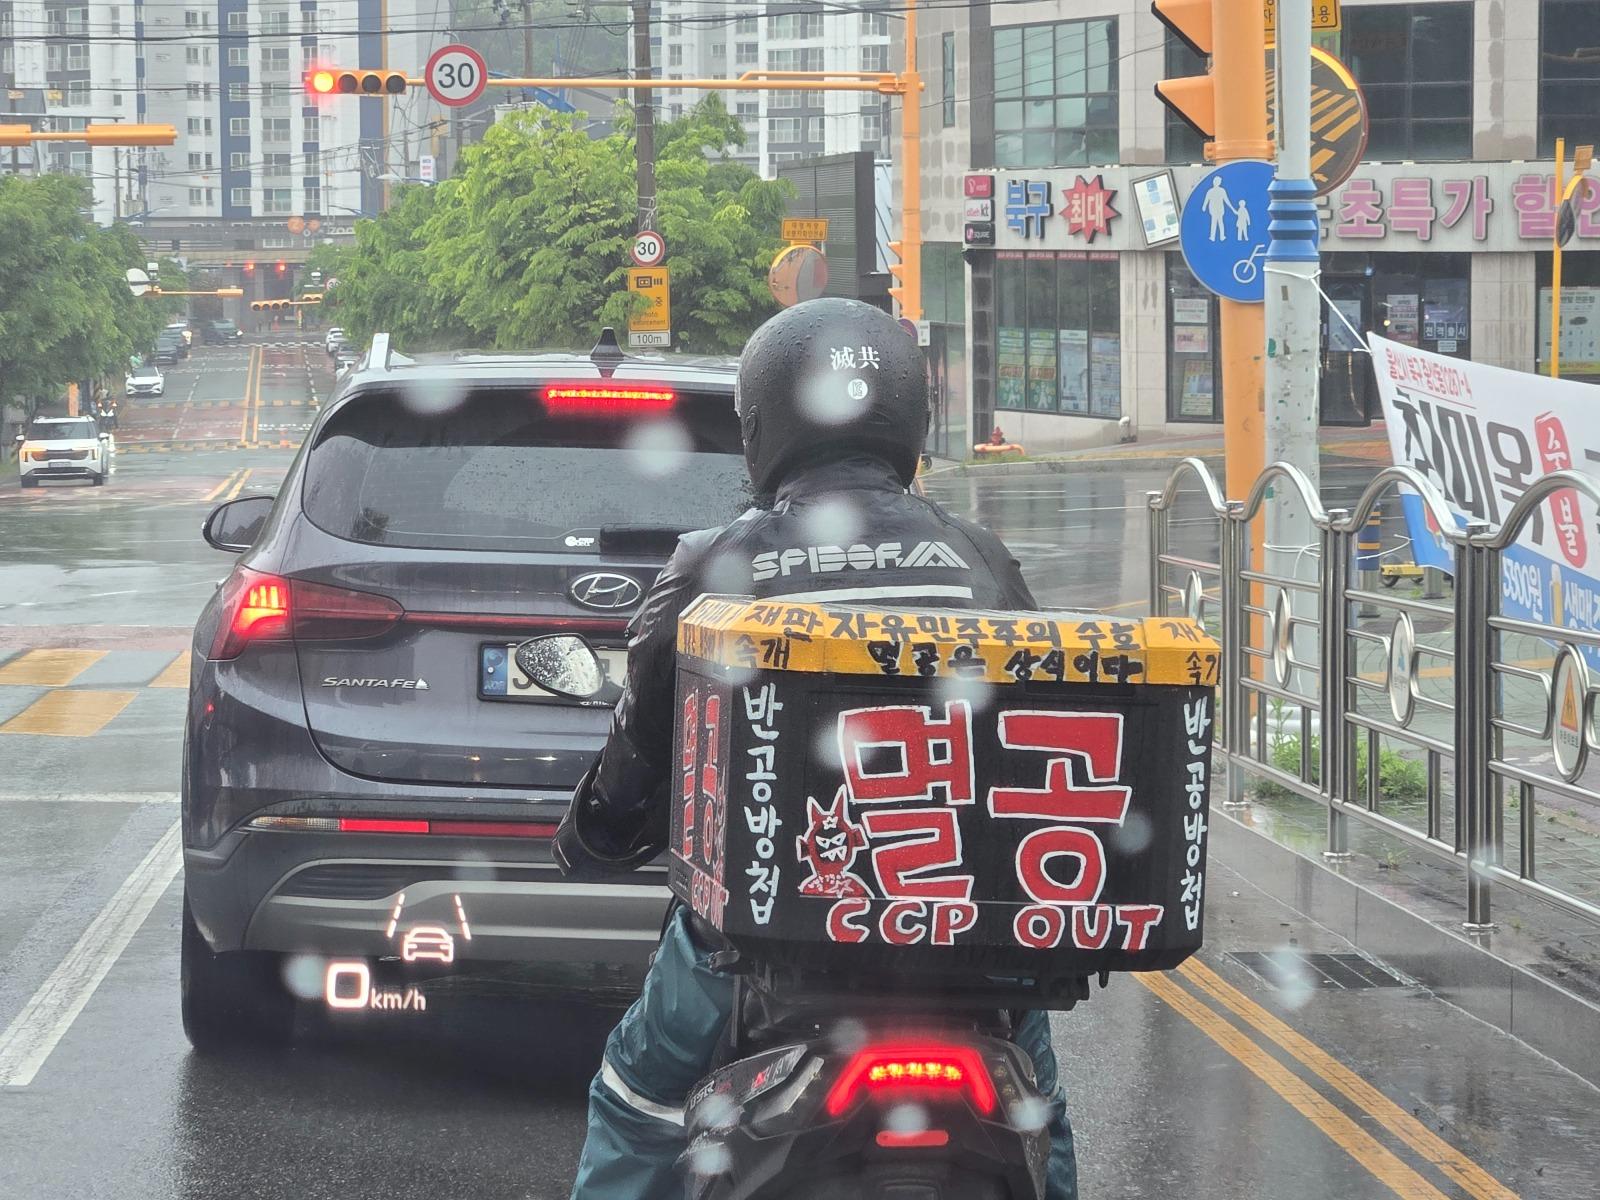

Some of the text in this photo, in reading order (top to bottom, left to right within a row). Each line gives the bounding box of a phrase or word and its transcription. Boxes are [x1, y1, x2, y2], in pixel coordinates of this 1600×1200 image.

[438, 62, 475, 89] 30
[1006, 179, 1104, 239] 북구 최대
[1336, 176, 1494, 241] 초특가
[637, 241, 657, 256] 30
[637, 334, 662, 344] 100m
[828, 611, 1142, 650] 자유민주주의 수호
[1004, 647, 1144, 685] 상식이다
[742, 682, 785, 925] 반공방첩
[837, 699, 1133, 905] 멸공
[1180, 695, 1211, 931] 반공방첩
[826, 898, 1165, 952] CCP OUT
[326, 962, 426, 1011] 0 km/h
